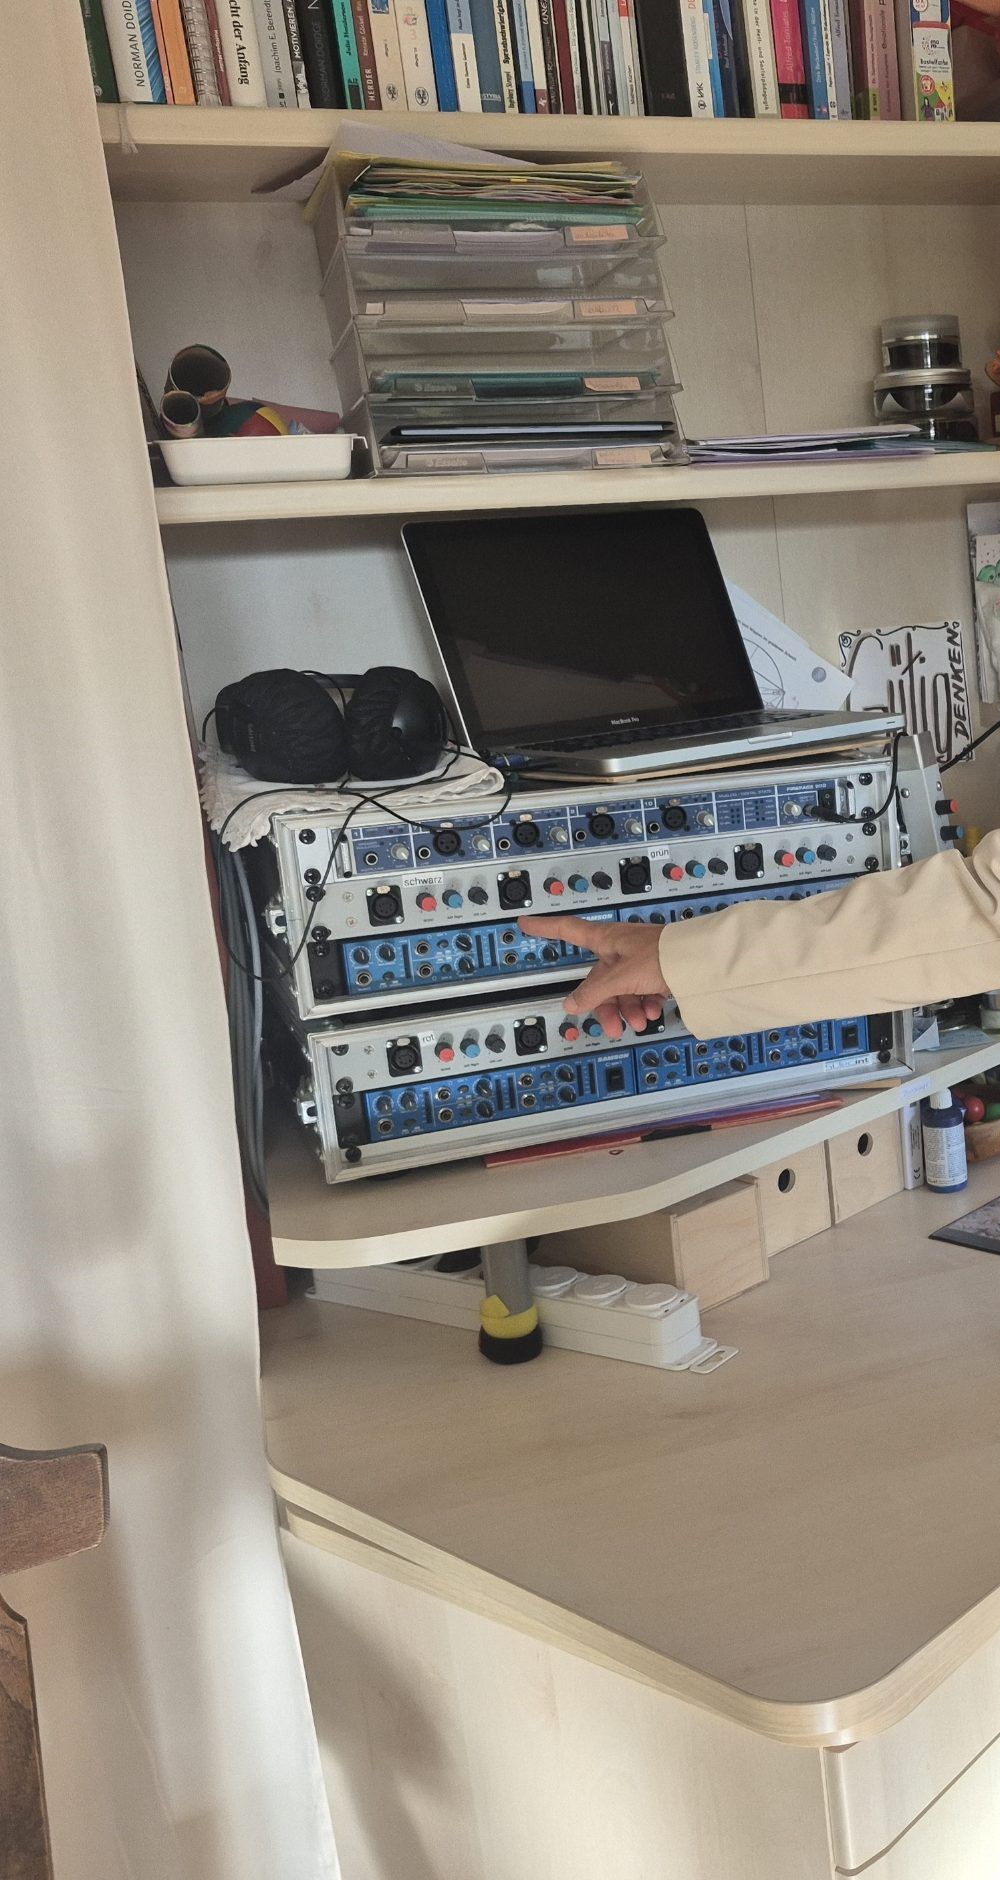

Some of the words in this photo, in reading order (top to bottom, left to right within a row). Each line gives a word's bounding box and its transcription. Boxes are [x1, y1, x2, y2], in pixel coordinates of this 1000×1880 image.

[231, 20, 244, 41] der
[129, 34, 145, 87] NORMAN
[235, 43, 251, 86] Anfang
[271, 42, 283, 74] Joachim
[366, 68, 376, 101] HERDER
[945, 628, 970, 741] DENKEN
[403, 874, 443, 887] schwarz
[422, 1033, 436, 1043] rot
[597, 1052, 631, 1063] SAMSON
